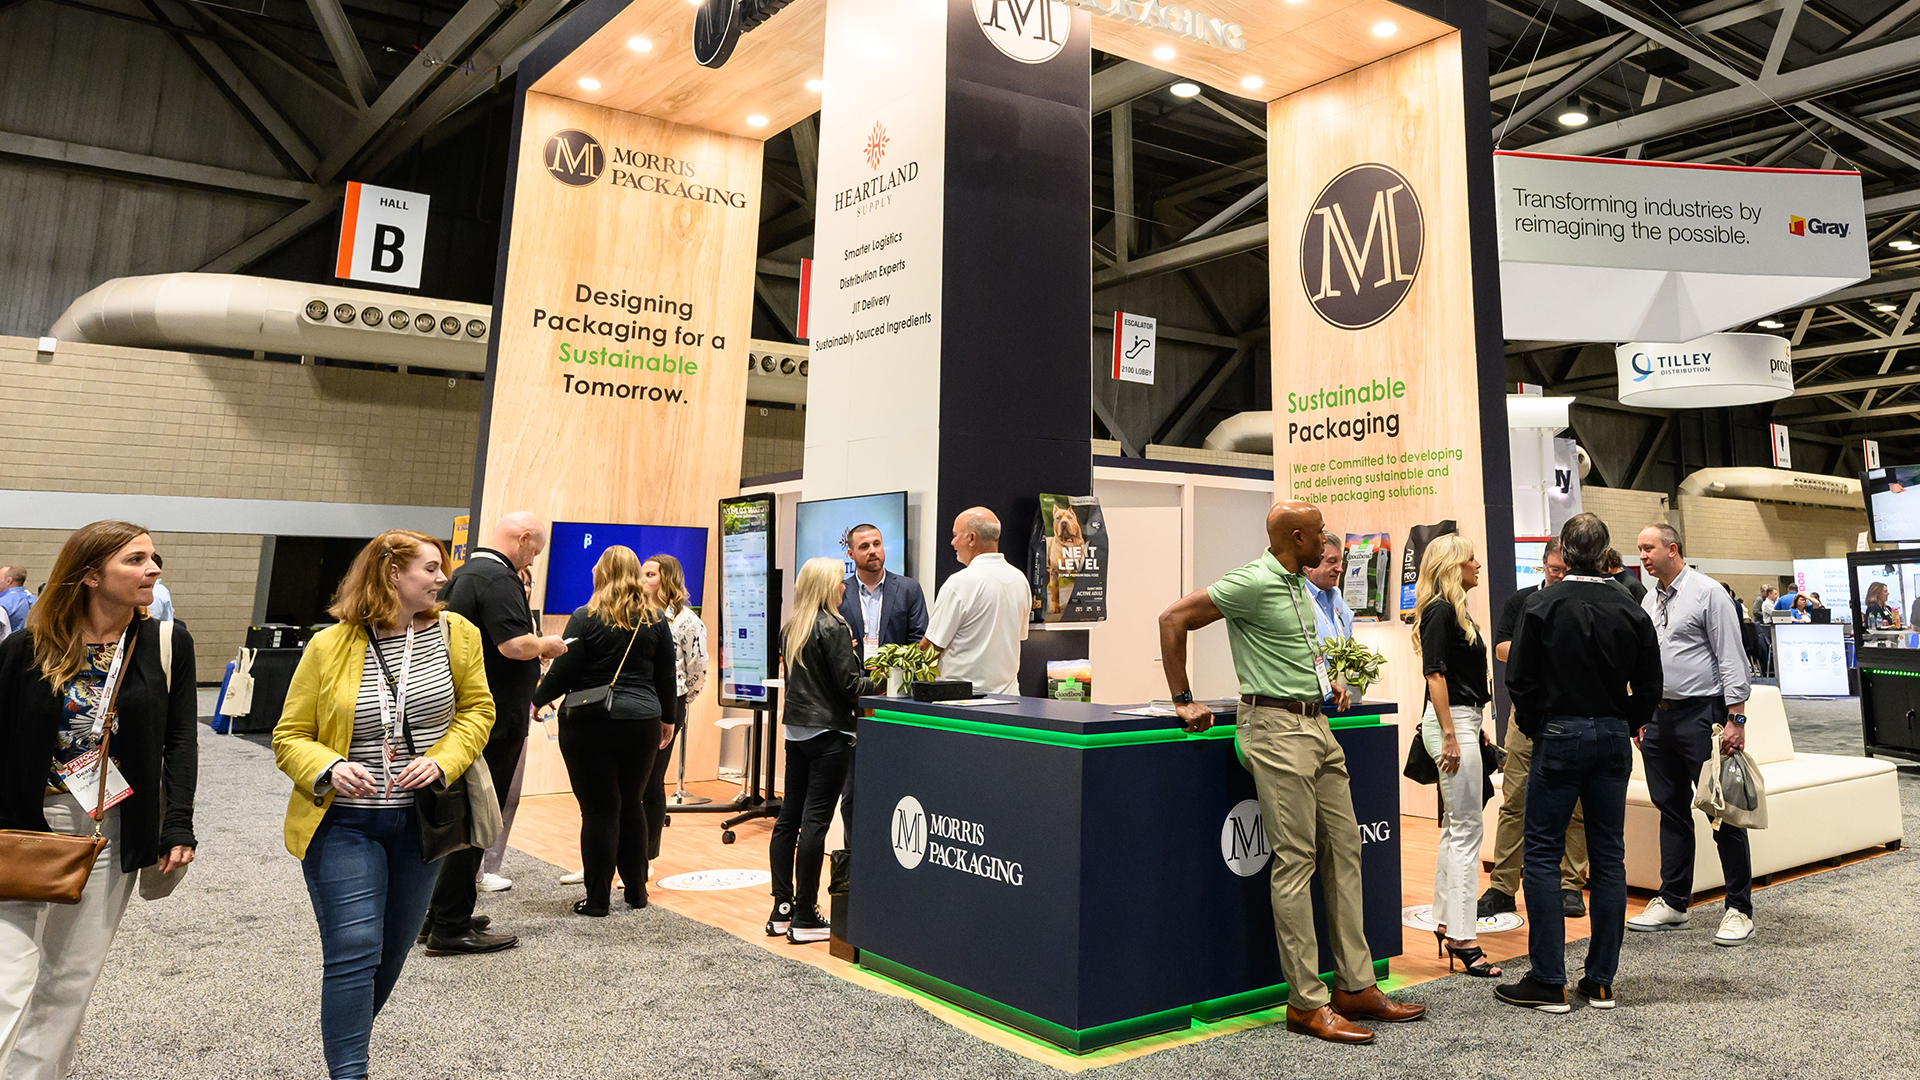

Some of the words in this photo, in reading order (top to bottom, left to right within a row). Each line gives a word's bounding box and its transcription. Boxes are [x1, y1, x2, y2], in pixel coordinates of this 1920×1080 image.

[612, 147, 696, 179] MORRIS
[610, 168, 747, 210] PACKAGING
[834, 161, 919, 212] HEARTLAND
[379, 197, 409, 211] HALL
[856, 194, 893, 218] SUPPLY
[1512, 187, 1637, 219] Transforming
[1644, 197, 1734, 220] industries
[1739, 202, 1762, 225] by
[1515, 214, 1625, 242] reimagining
[1631, 221, 1662, 240] the
[1668, 225, 1750, 245] possible.
[1808, 218, 1850, 238] Gray
[370, 223, 405, 274] B
[843, 243, 871, 261] Smarter
[872, 232, 903, 251] Logistics
[839, 269, 878, 290] Distribution
[878, 259, 906, 277] Experts
[575, 283, 693, 321] Designing
[851, 301, 861, 315] JIT
[861, 293, 891, 311] Delivery
[533, 308, 667, 347] Packaging
[674, 326, 704, 347] for
[711, 335, 725, 349] a
[815, 332, 855, 352] Sustainably
[855, 322, 886, 342] Sourced
[886, 312, 932, 335] Ingredients
[1124, 318, 1154, 330] ESCALATOR
[558, 342, 698, 375] Sustainable
[1121, 365, 1135, 374] 2100
[1135, 367, 1153, 377] LOBBY
[1657, 352, 1712, 368] TILLEY
[1660, 366, 1711, 376] DISTRIBUTION
[447, 378, 457, 389] 9
[563, 373, 688, 404] Tomorrow.
[1287, 376, 1406, 414] Sustainable
[759, 408, 769, 417] 10
[1288, 411, 1400, 443] Packaging
[1293, 463, 1308, 474] We
[1310, 463, 1326, 473] are
[1328, 454, 1384, 471] Committed
[1386, 454, 1397, 465] to
[1400, 447, 1463, 464] developing
[1294, 477, 1312, 490] and
[1314, 473, 1362, 488] delivering
[1365, 466, 1424, 484] sustainable
[1427, 465, 1449, 478] and
[1330, 488, 1386, 505] packaging
[1388, 483, 1438, 499] solutions.
[1058, 558, 1100, 571] LEVEL
[1062, 544, 1098, 559] NEXT
[895, 808, 923, 855] M
[929, 813, 985, 847] MORRIS
[928, 841, 1024, 886] PACKAGING
